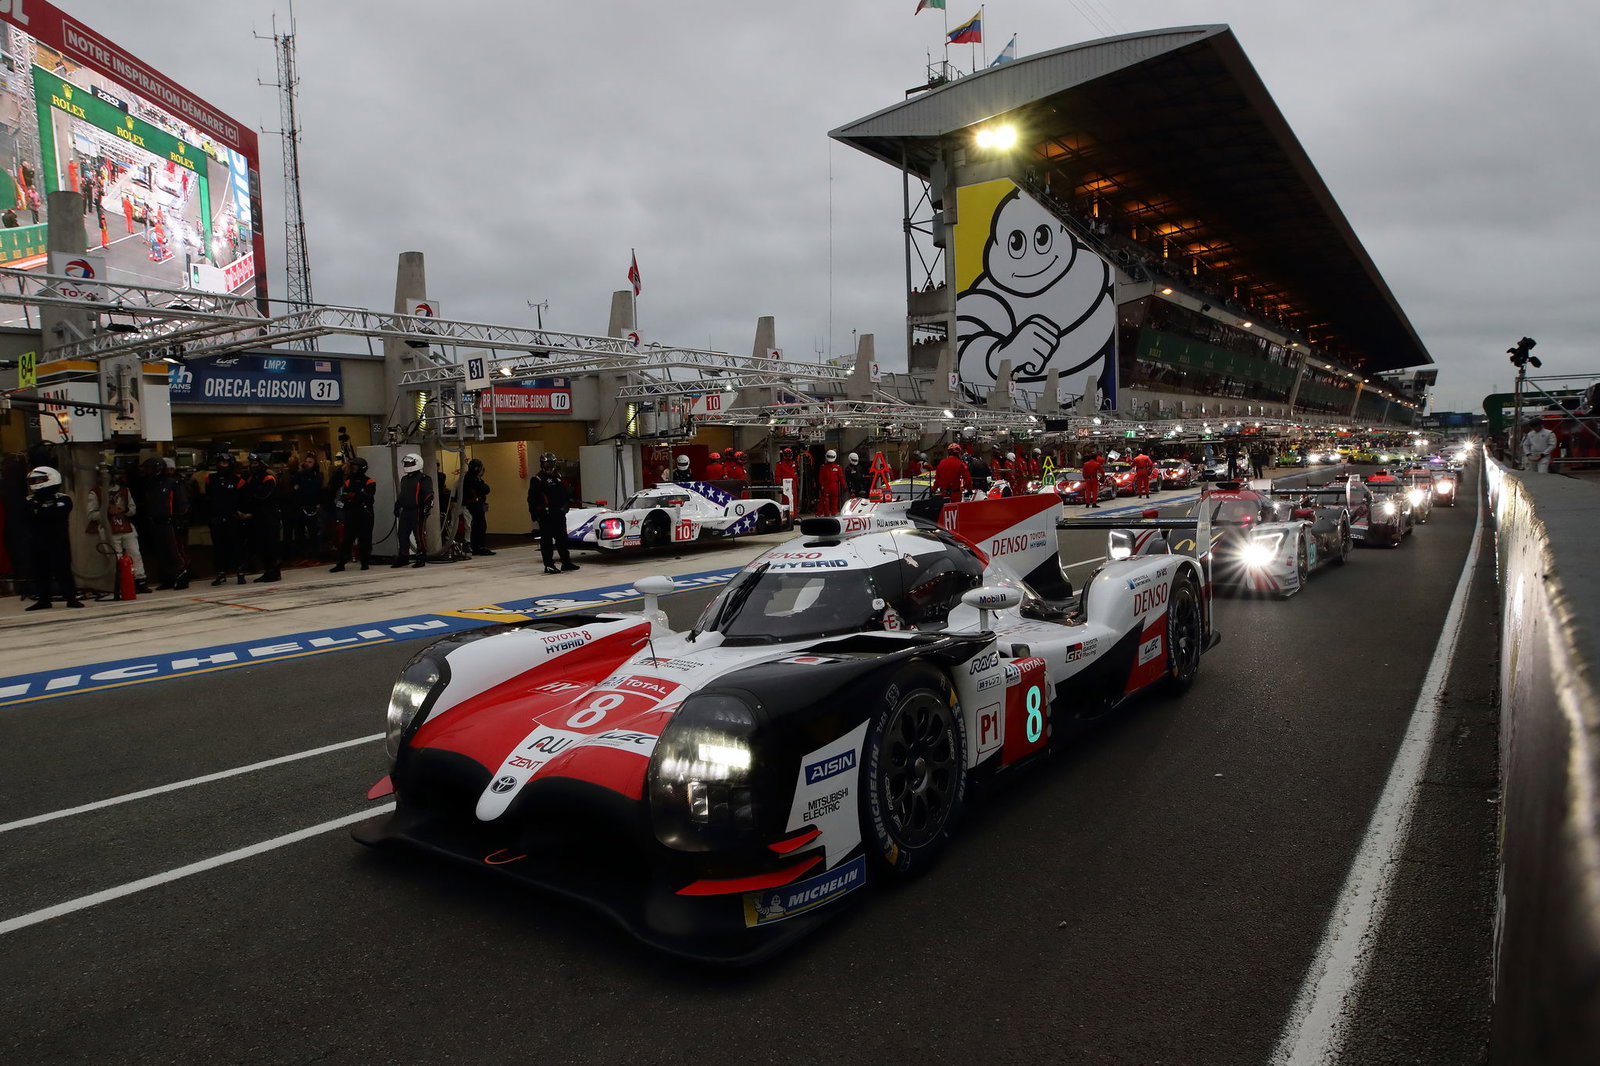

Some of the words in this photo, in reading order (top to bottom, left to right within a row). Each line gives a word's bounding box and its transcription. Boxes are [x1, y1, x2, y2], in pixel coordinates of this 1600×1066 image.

[68, 29, 110, 67] NOTRE
[112, 56, 180, 109] INSPIRATION
[181, 97, 225, 136] DÉMARRE
[224, 126, 237, 141] ICI
[52, 94, 86, 119] ROLEX
[117, 126, 145, 147] ROLEX
[170, 151, 195, 170] ROLEX
[21, 353, 33, 380] 84
[263, 359, 287, 373] LMP2
[470, 360, 484, 380] 31
[205, 378, 306, 399] ORECA-GIBSON
[316, 382, 333, 398] 31
[74, 404, 99, 417] 84
[482, 394, 492, 408] BR
[556, 394, 566, 408] 10
[708, 396, 720, 410] 10
[1126, 430, 1136, 438] 71
[843, 517, 871, 532] ZENT
[884, 520, 899, 528] AISIN
[943, 511, 959, 533] HY
[677, 526, 690, 540] 10
[992, 534, 1028, 558] DENSO
[1030, 531, 1046, 540] TOYOTA
[771, 559, 848, 569] HYBRID
[1134, 582, 1168, 618] DENSO
[541, 630, 580, 647] TOYOTA
[545, 638, 586, 655] HYBRID
[583, 630, 592, 644] 8
[970, 651, 999, 675] RAYS
[1018, 658, 1045, 673] TOTAL
[1067, 650, 1082, 662] GR
[626, 679, 668, 695] TOTAL
[566, 694, 625, 729] 8
[1026, 685, 1043, 744] 8
[981, 710, 999, 746] P1
[508, 756, 544, 771] ZENT
[811, 753, 854, 785] AISIN
[808, 787, 850, 811] MITSUBISHI
[869, 743, 888, 840] MICHELIN
[803, 801, 841, 822] ELECTRIC
[787, 868, 859, 908] MICHELIN
